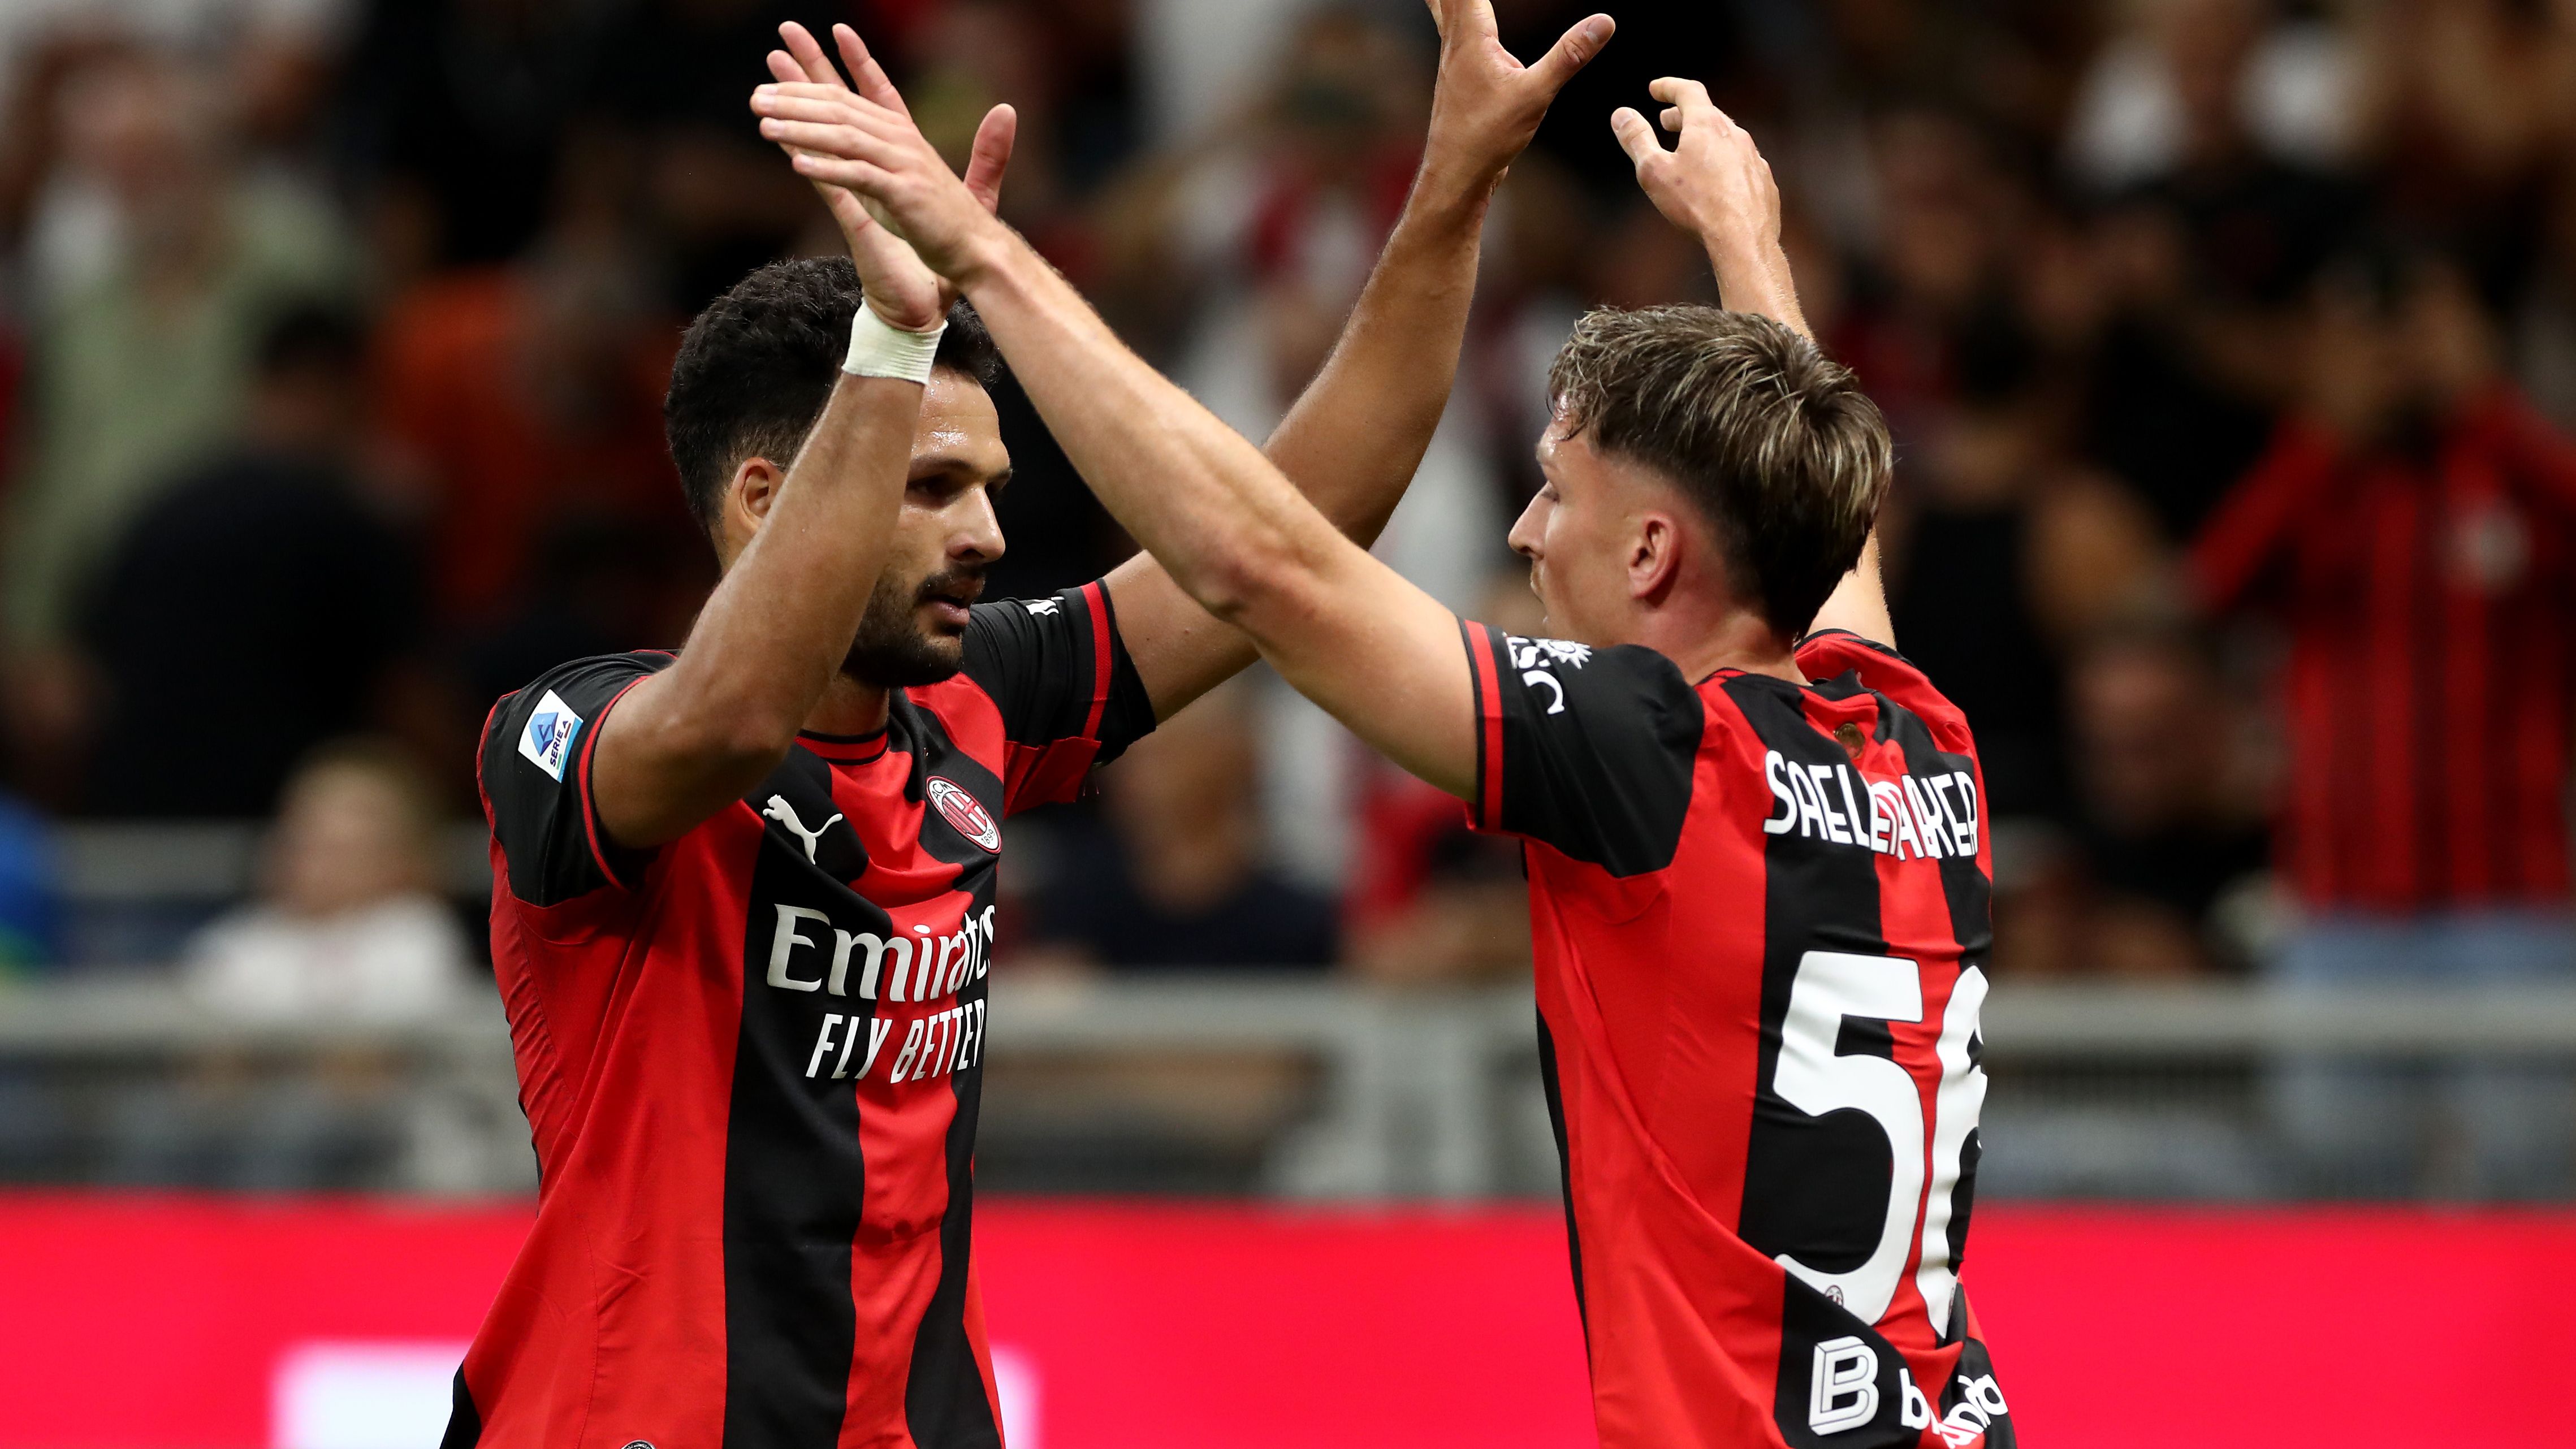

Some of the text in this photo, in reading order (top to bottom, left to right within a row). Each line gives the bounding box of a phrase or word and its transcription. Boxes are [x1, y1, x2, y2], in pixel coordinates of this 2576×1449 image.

[550, 720, 568, 767] SERIE A
[932, 782, 953, 803] ACM
[981, 829, 995, 845] 1899
[806, 1013, 892, 1079] FLY
